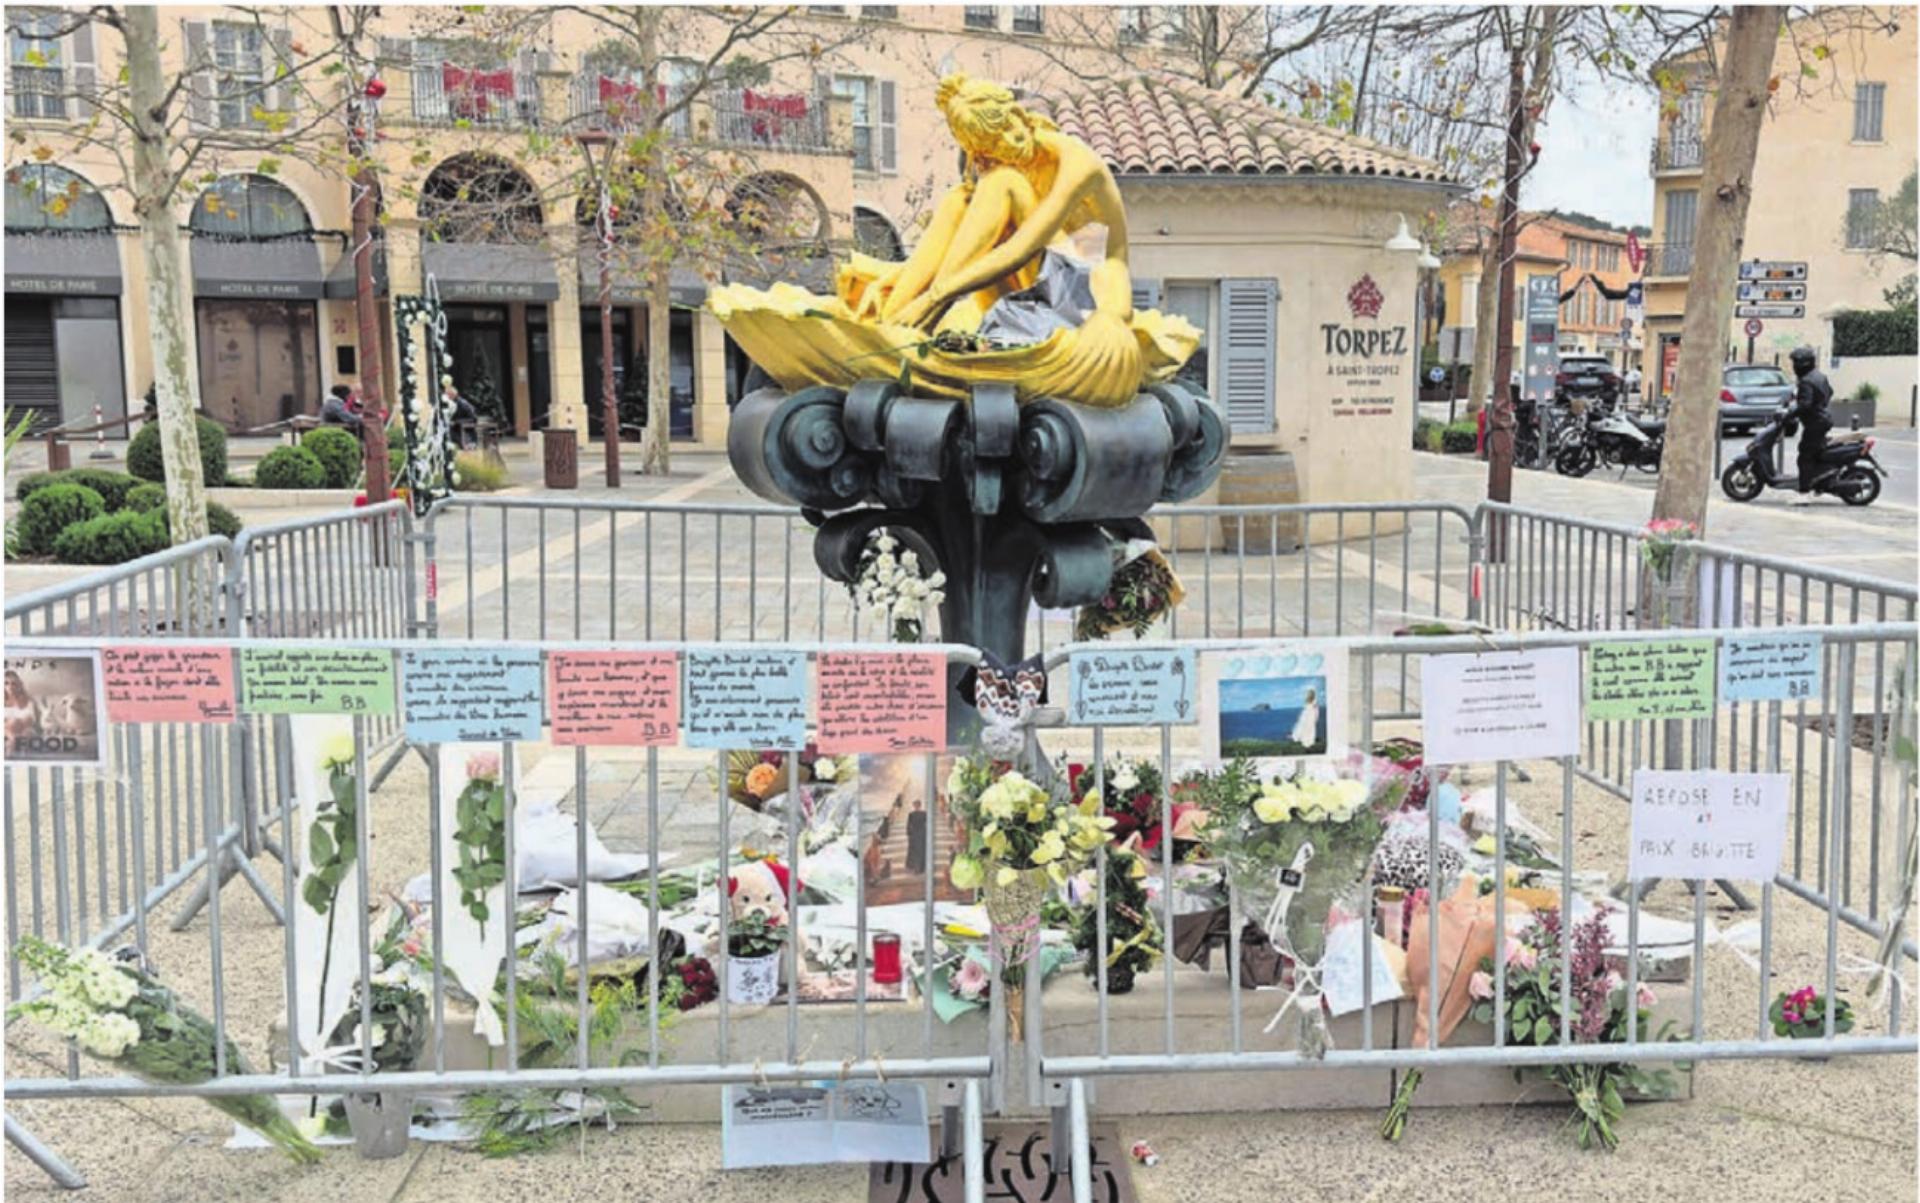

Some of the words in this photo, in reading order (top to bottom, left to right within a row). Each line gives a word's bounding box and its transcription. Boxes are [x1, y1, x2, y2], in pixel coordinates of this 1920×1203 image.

[10, 279, 46, 289] HOTEL
[50, 280, 64, 290] DE
[66, 280, 96, 291] PARIS
[220, 284, 252, 294] HOTEL
[256, 285, 270, 294] DE
[272, 284, 299, 295] PARIS
[1320, 323, 1408, 359] TORPEZ
[15, 736, 78, 752] FOOD
[1643, 787, 1711, 806] REPOSE
[1732, 784, 1762, 807] EN
[1639, 839, 1676, 858] PAIX
